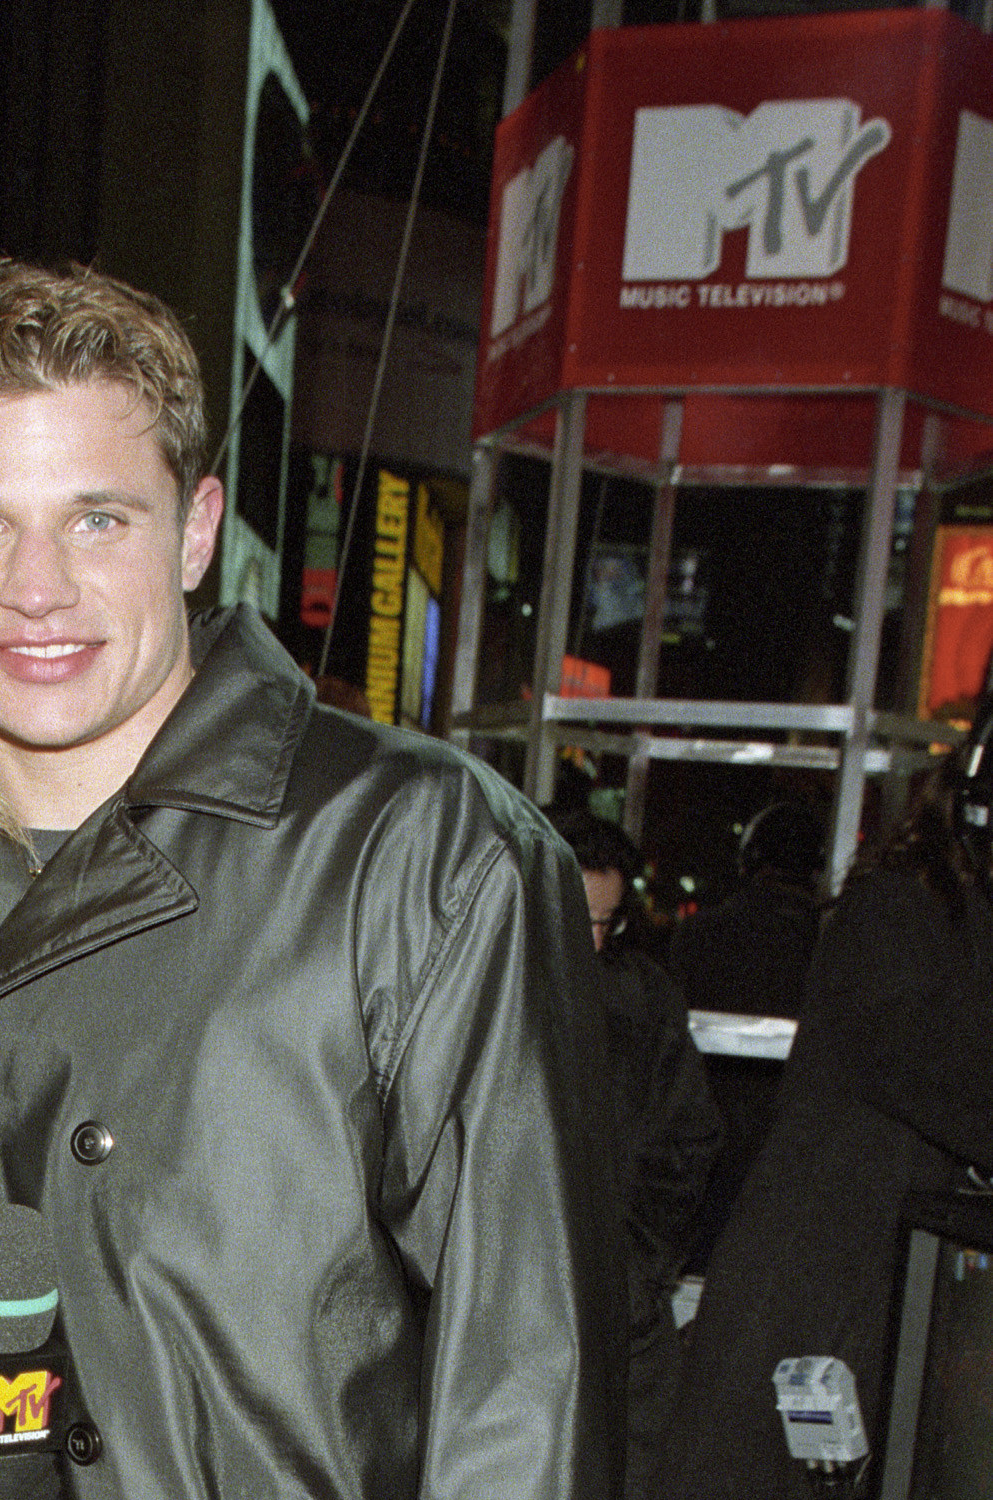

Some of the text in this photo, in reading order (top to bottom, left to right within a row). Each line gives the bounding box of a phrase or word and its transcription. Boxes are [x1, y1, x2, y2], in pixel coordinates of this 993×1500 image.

[621, 97, 892, 282] MTV
[619, 285, 691, 309] MUSIC
[371, 470, 410, 616] GALLERY
